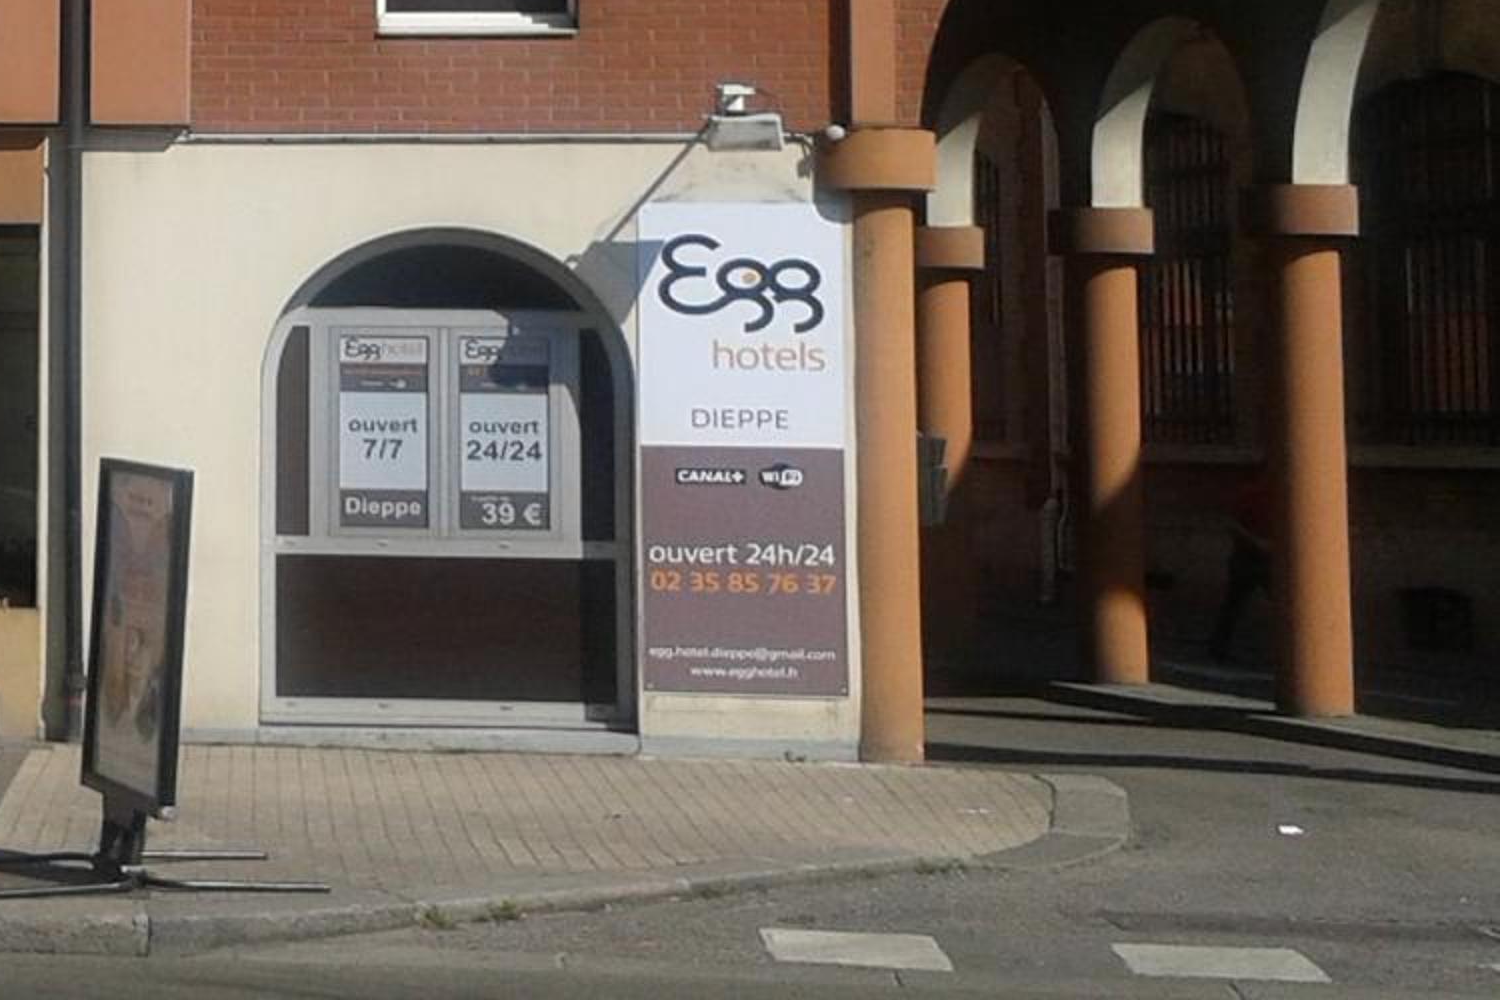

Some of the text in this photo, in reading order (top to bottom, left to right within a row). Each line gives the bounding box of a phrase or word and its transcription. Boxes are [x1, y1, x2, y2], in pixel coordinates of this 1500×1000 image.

[658, 234, 824, 333] Egg
[712, 339, 826, 372] hotels
[348, 418, 418, 433] ouvert
[469, 420, 539, 435] ouvert
[691, 408, 788, 429] DIEPPE
[363, 438, 403, 459] 7/7
[467, 440, 541, 461] 24/24
[677, 469, 744, 483] CANAL+
[345, 497, 422, 519] Dieppe
[481, 502, 542, 525] 39 €
[649, 543, 836, 566] ouvert 24h/24
[650, 570, 836, 595] 02 35 85 76 37
